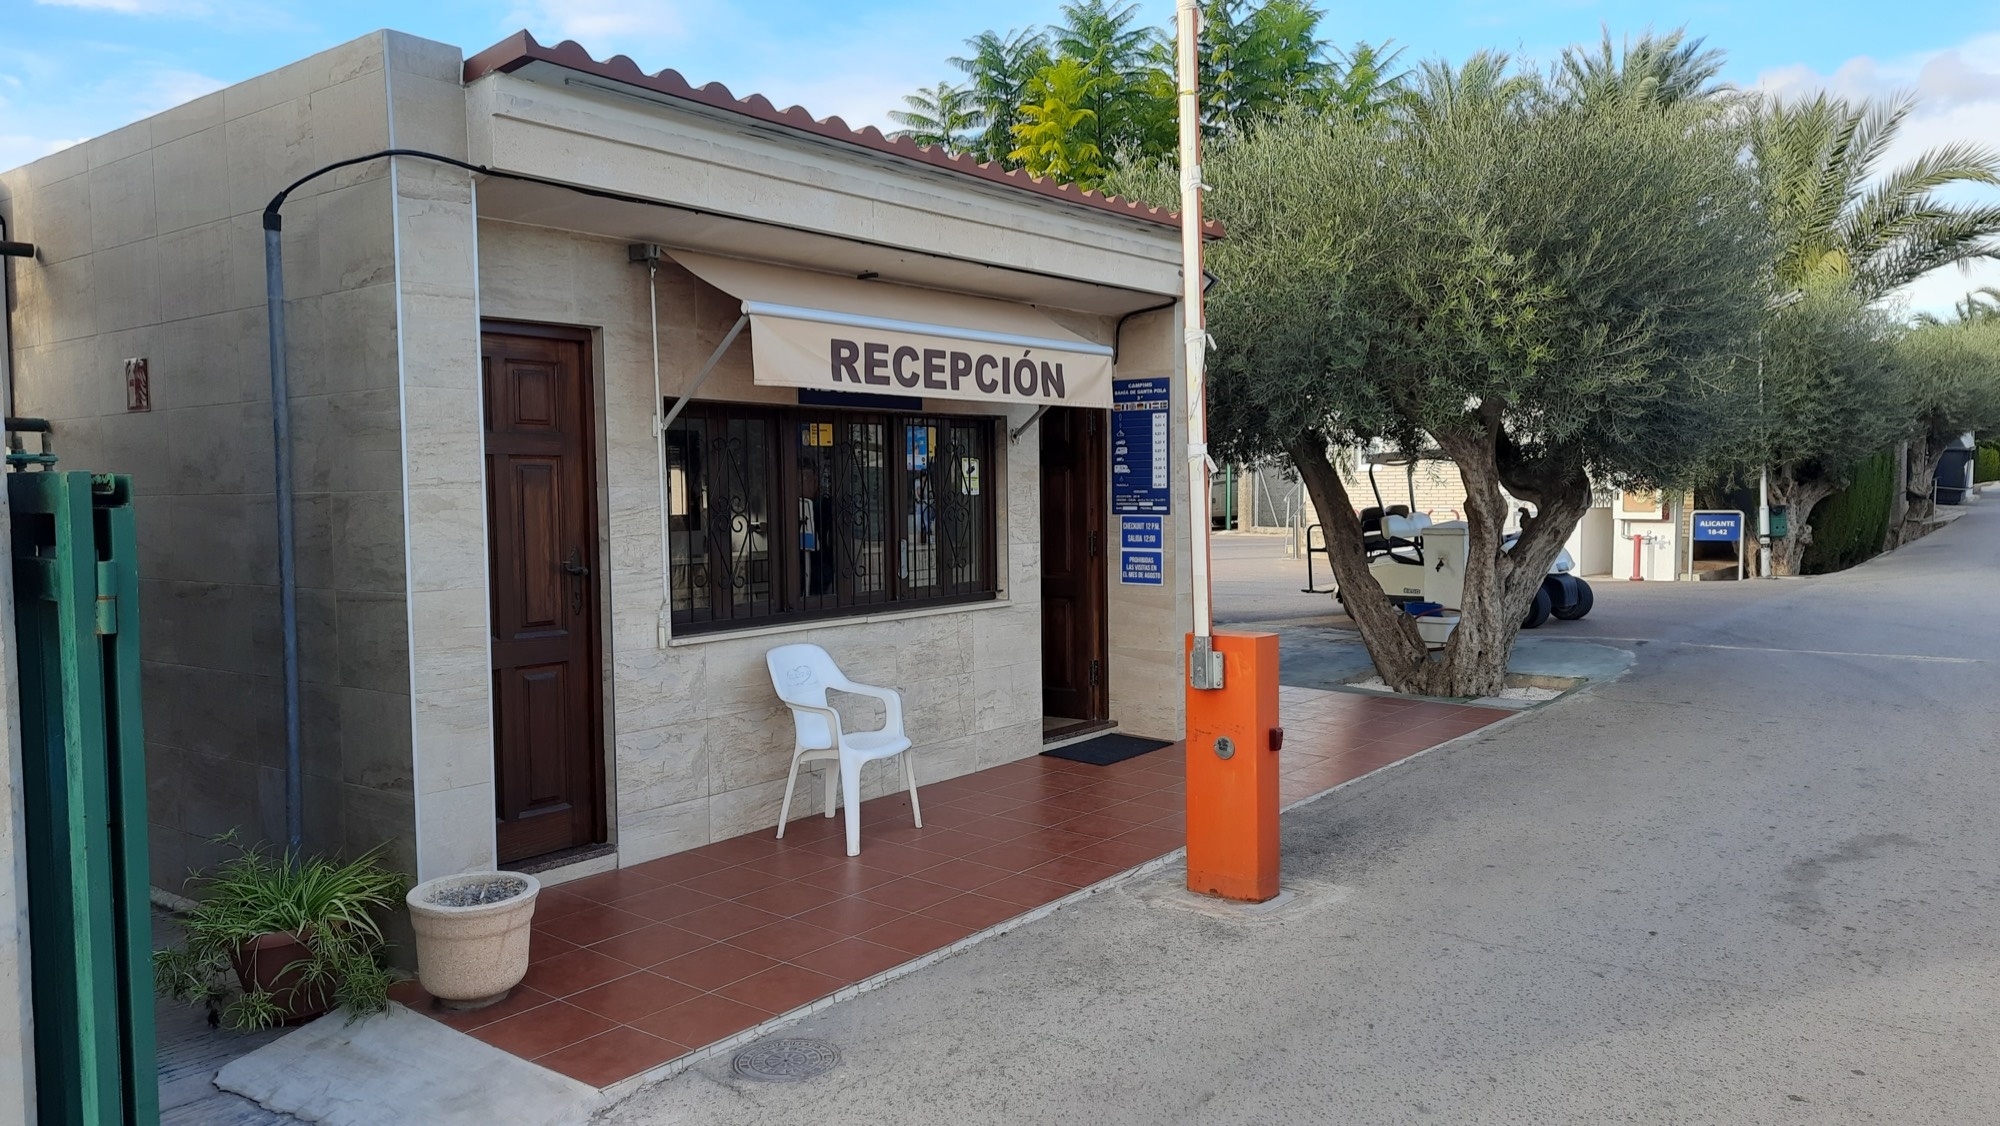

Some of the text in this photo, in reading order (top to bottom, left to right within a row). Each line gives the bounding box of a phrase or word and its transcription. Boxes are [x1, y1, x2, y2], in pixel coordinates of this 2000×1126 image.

[830, 338, 1065, 399] RECEPCIÓN
[1123, 522, 1144, 530] CHECKOUT
[1146, 522, 1151, 530] 12
[1128, 534, 1156, 543] SALIDA 12:00
